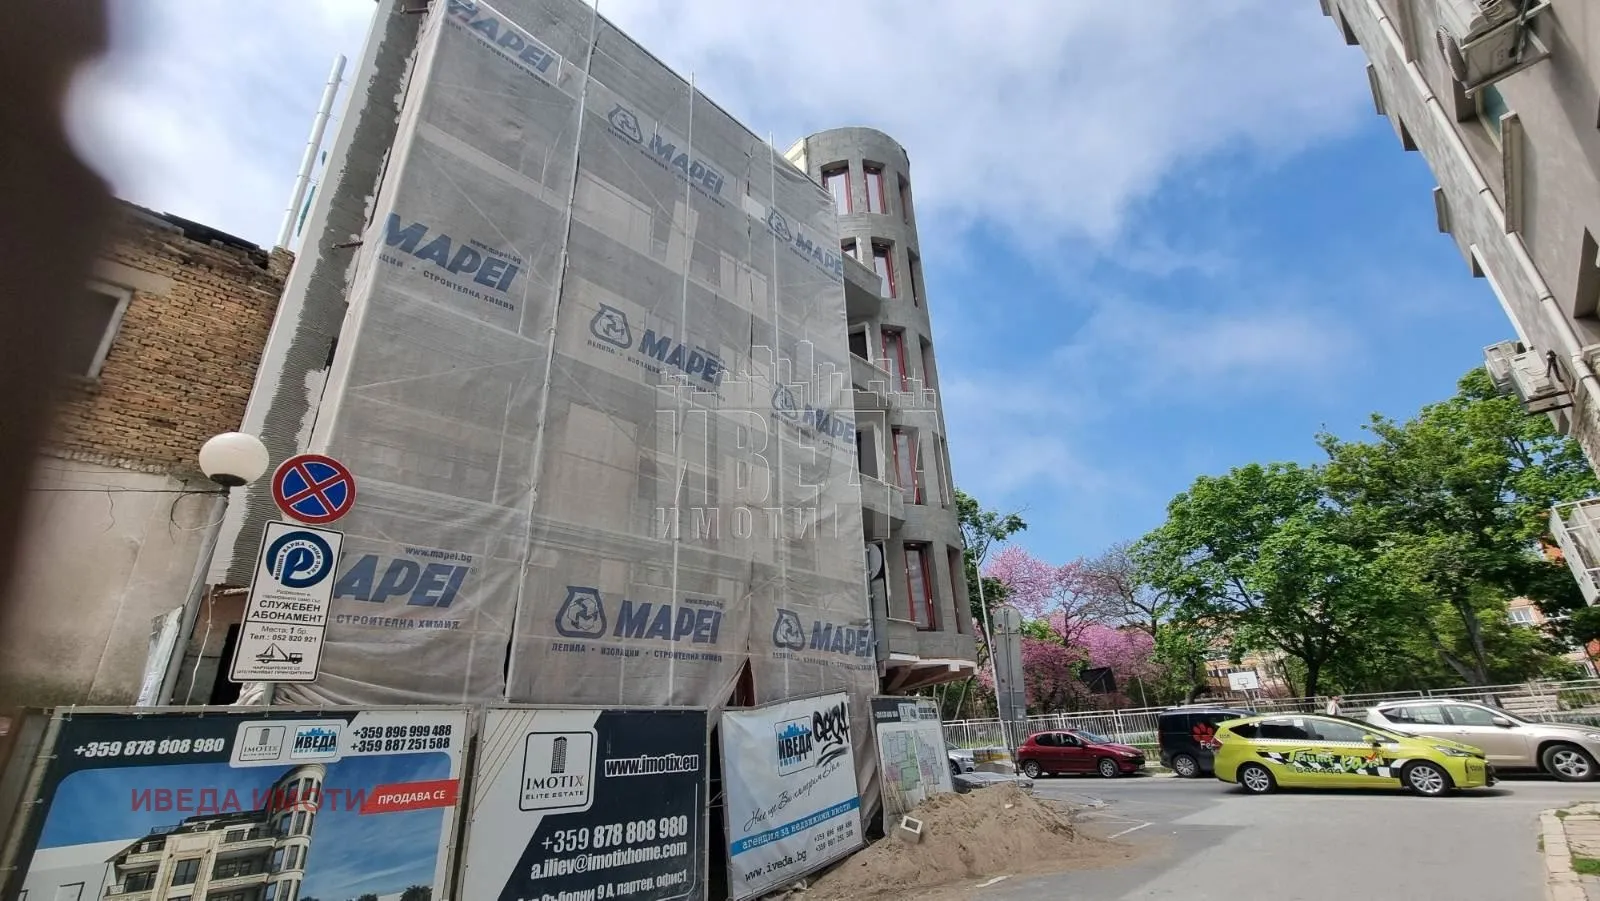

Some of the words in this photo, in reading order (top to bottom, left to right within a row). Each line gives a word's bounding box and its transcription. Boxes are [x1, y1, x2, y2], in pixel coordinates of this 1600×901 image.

[648, 133, 725, 195] MAPEI
[385, 212, 519, 293] MAPEI
[638, 328, 724, 387] MAPEI
[405, 546, 473, 563] www.mapei.bg
[333, 552, 471, 609] APEI
[251, 610, 324, 623] АБОНАМЕНТ
[259, 599, 321, 612] СЛУЖЕБЕН
[336, 614, 414, 629] СТРОИТЕЛНА
[417, 619, 461, 630] ХИМИЯ
[612, 600, 722, 644] MAPEI
[551, 642, 586, 653] ЛЕПИЛА
[600, 646, 640, 658] ИЗОЛАЦИИ
[653, 649, 699, 661] СТРОИТЕЛНА
[353, 726, 383, 739] +359
[384, 726, 408, 738] 896
[409, 725, 431, 737] 999
[431, 724, 452, 736] 488
[74, 741, 122, 758] +359
[123, 740, 157, 756] 878
[157, 739, 191, 754] 808
[193, 737, 225, 753] 980
[294, 735, 337, 752] ИВЕДА
[350, 740, 383, 752] +359
[384, 739, 407, 751] 887
[407, 738, 428, 751] 251
[428, 737, 451, 750] 588
[778, 731, 813, 762] ИВЕДА
[605, 753, 699, 778] www.imotix.eu
[525, 775, 585, 790] IMOTIX
[377, 791, 431, 805] ПРОДАВА
[432, 789, 446, 800] СЕ
[525, 793, 550, 801] ELITE
[551, 790, 585, 799] ESTATE
[541, 827, 590, 853] +359
[592, 822, 623, 849] 878
[625, 818, 656, 844] 808
[658, 814, 688, 839] 980
[742, 831, 780, 850] агенция
[780, 827, 790, 838] за
[530, 841, 688, 880] a.iliev@imotixhome.com
[744, 850, 808, 882] www.iveda.bg
[597, 884, 605, 901] 9
[616, 875, 655, 896] партер,
